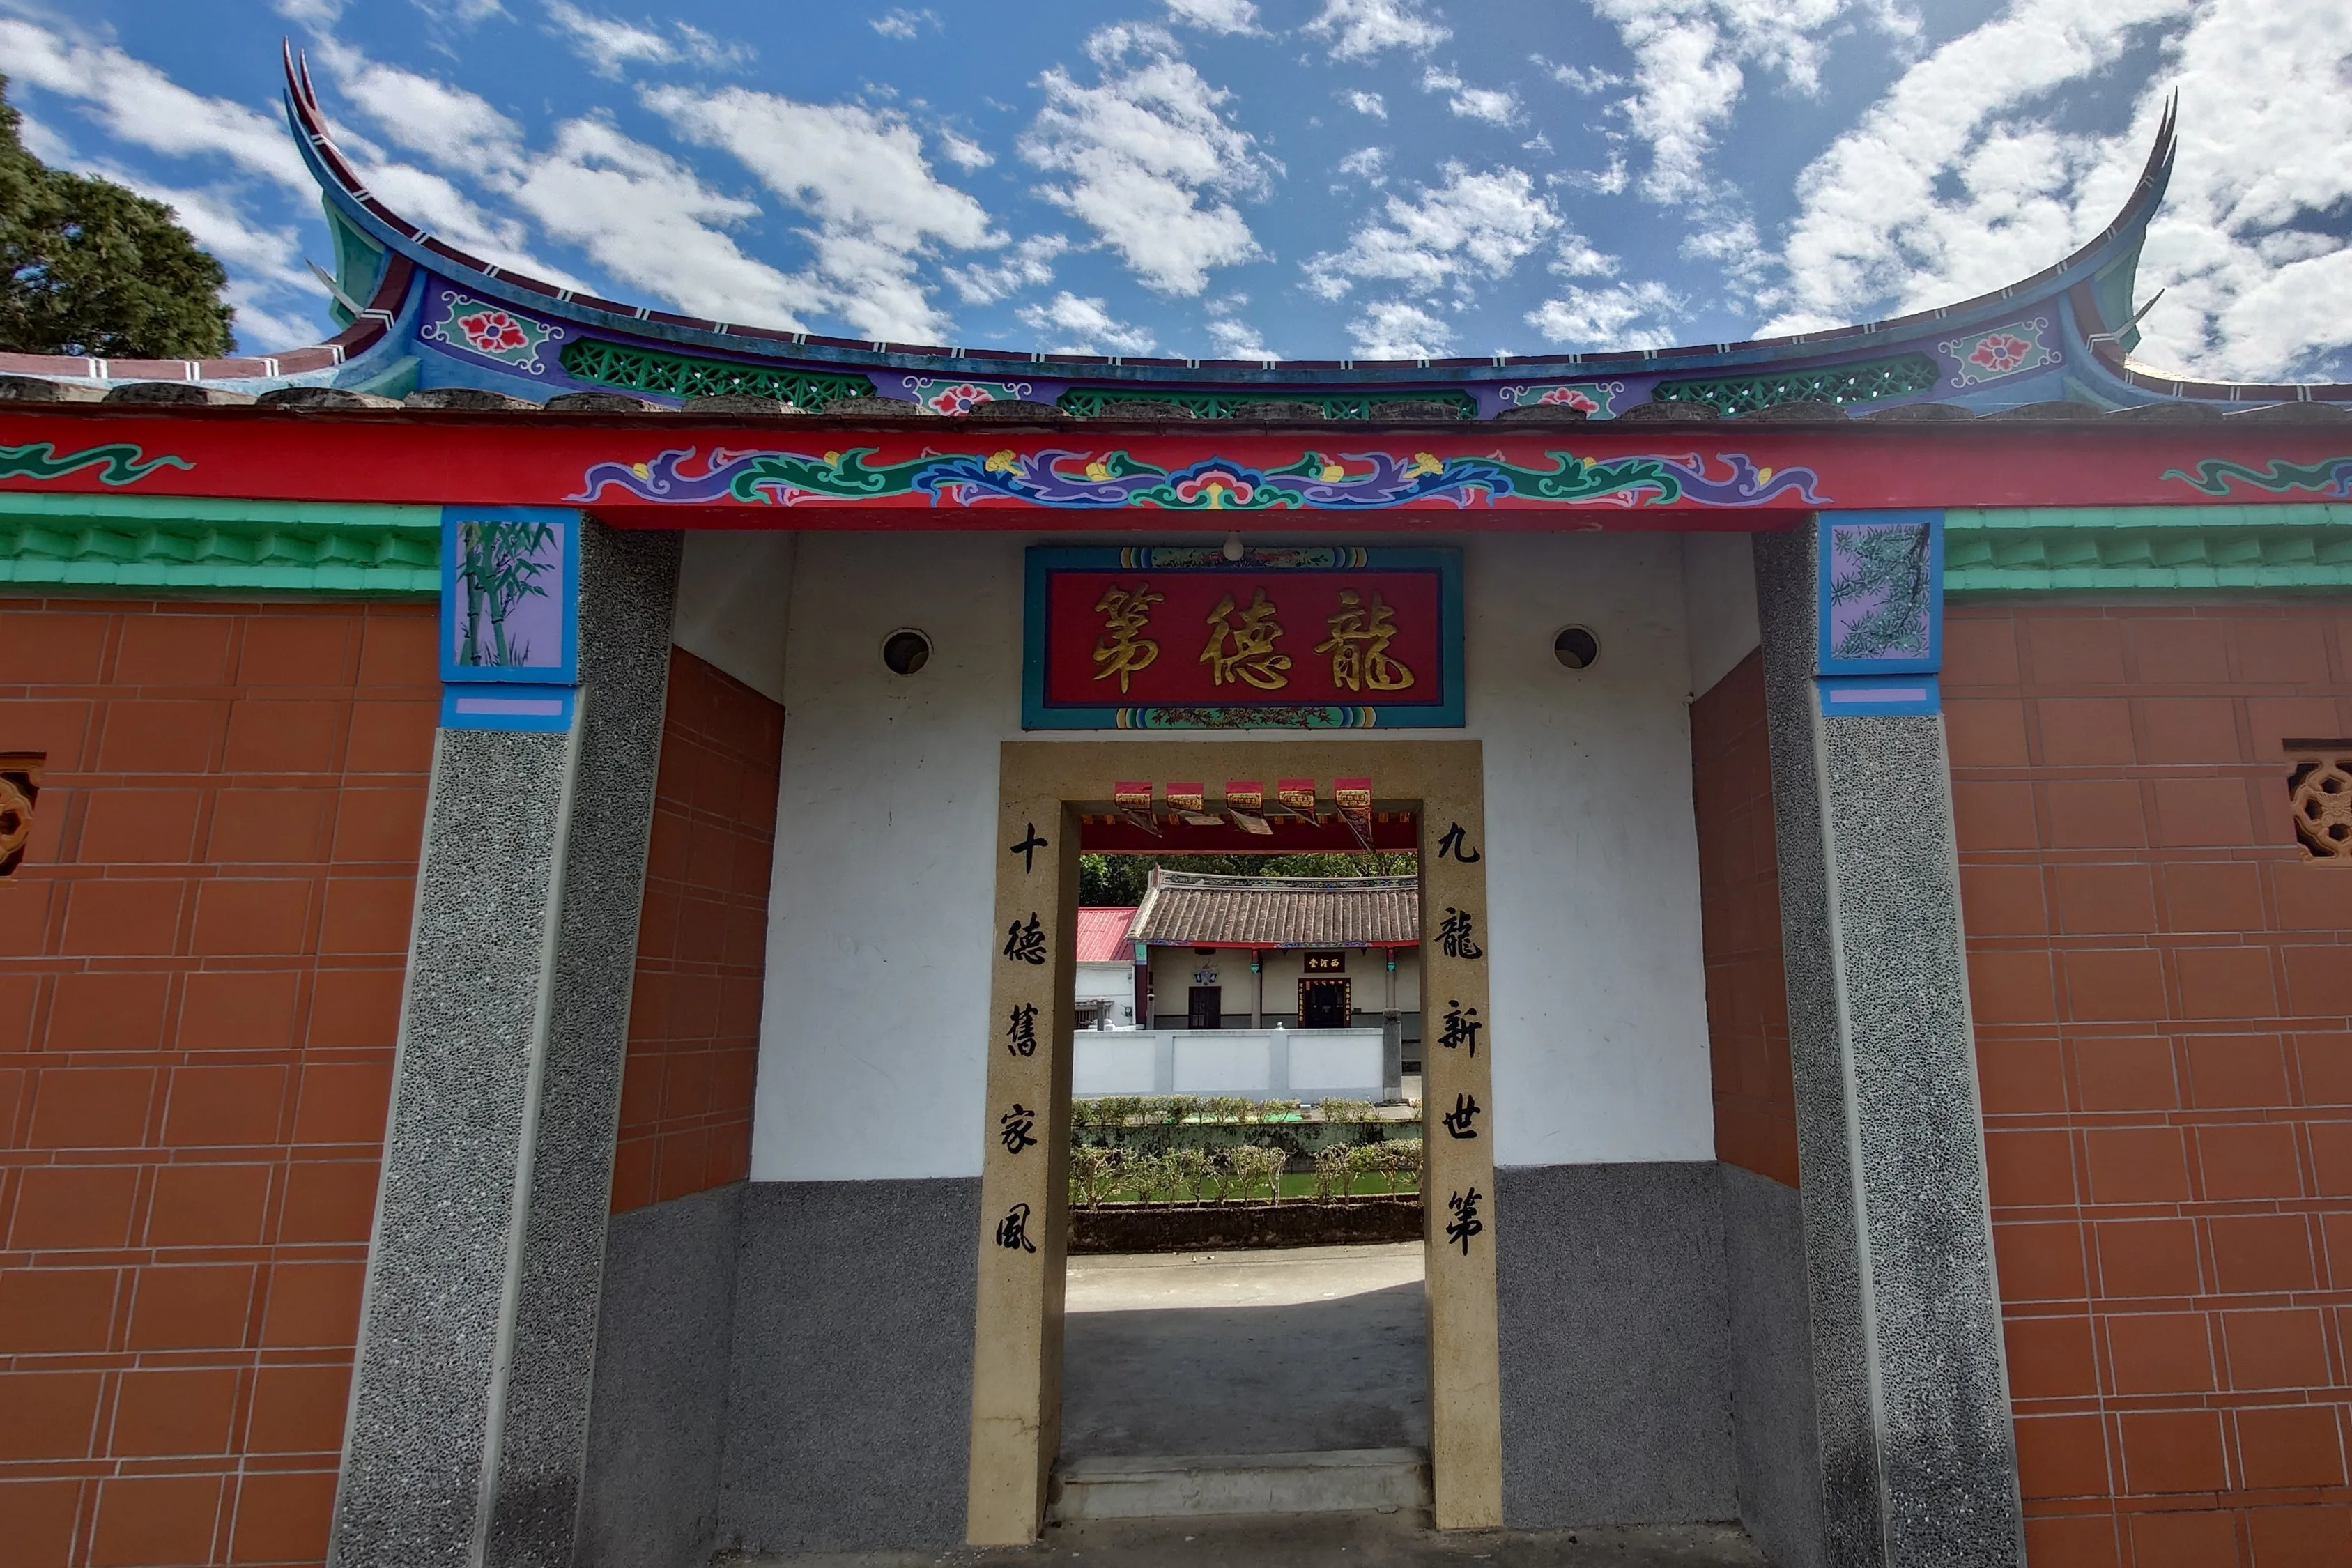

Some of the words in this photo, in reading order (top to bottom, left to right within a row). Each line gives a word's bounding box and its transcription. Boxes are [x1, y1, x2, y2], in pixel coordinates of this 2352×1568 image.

[1434, 821, 1484, 1256] 九龍新世第
